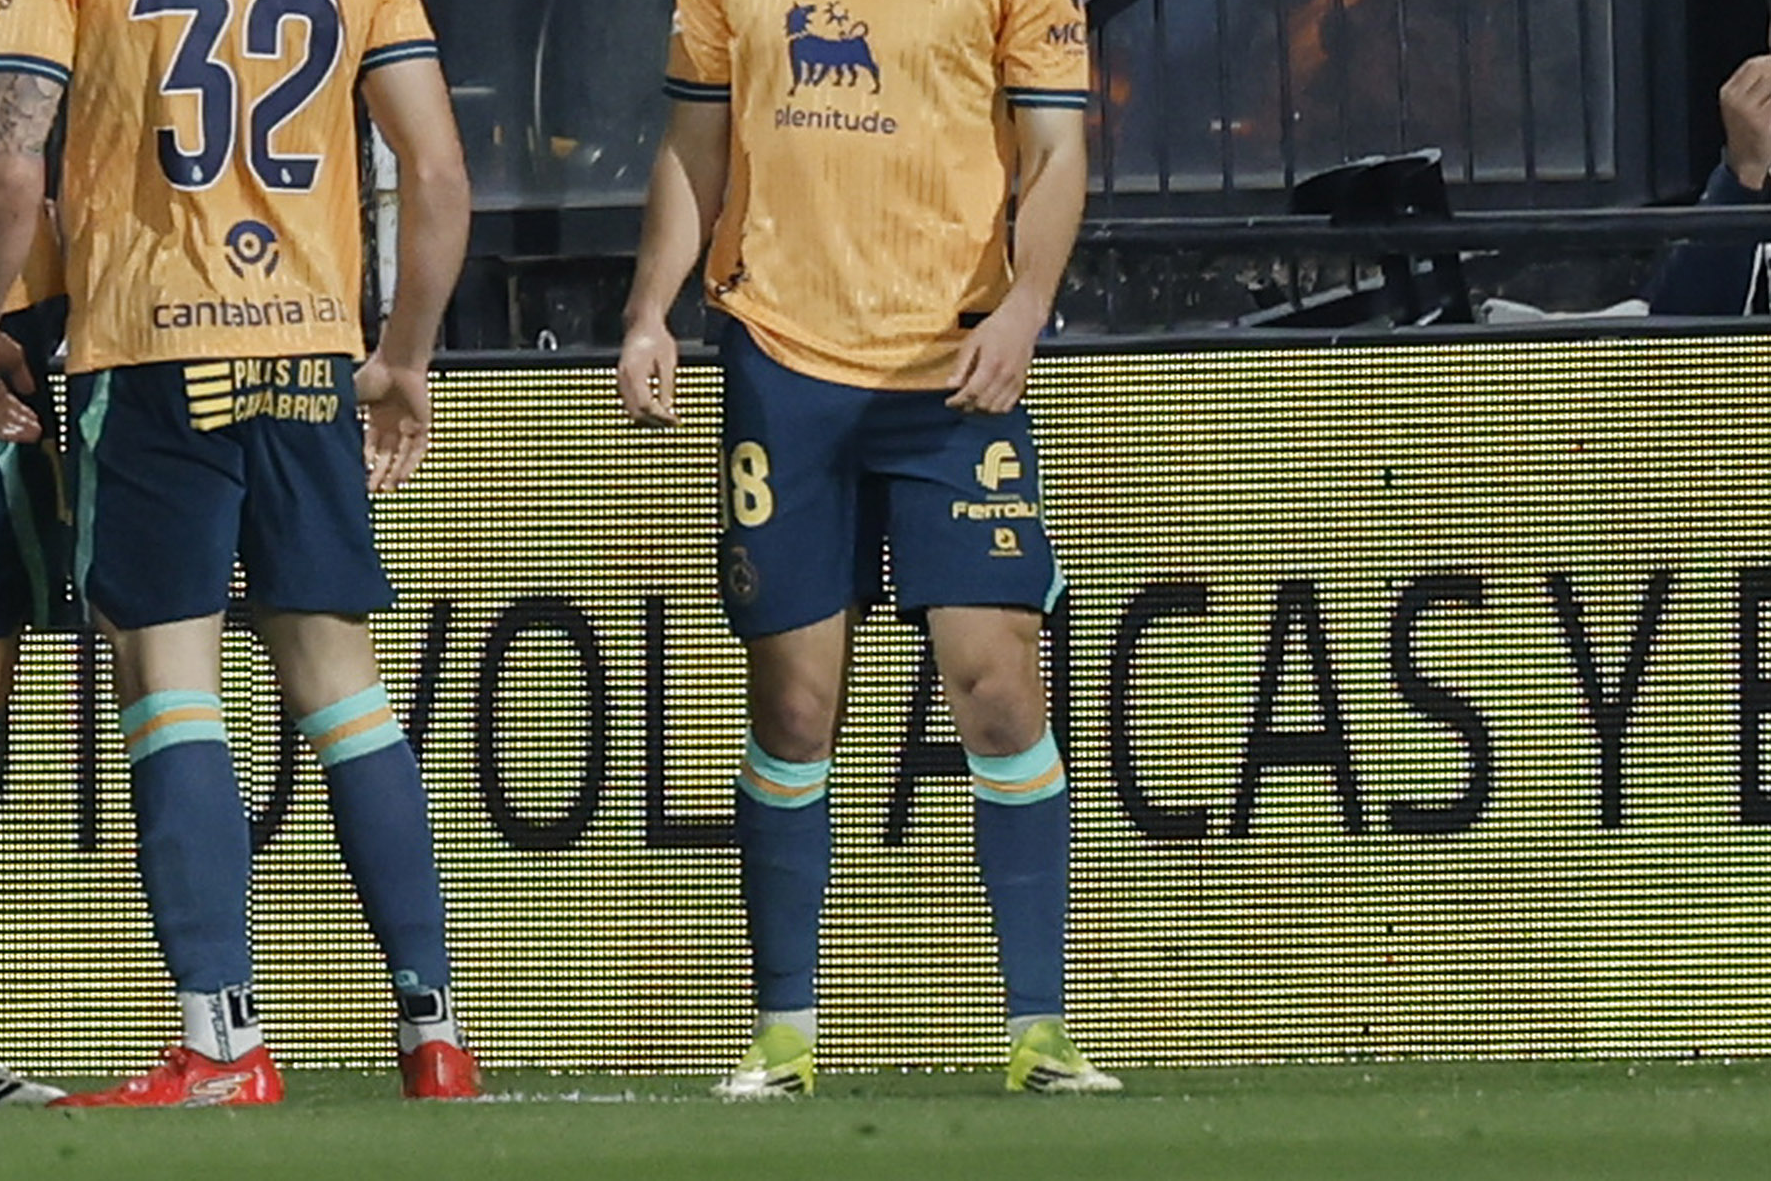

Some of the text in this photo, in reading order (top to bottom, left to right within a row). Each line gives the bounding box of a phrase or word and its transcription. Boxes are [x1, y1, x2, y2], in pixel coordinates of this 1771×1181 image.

[775, 104, 898, 135] plenitude
[153, 294, 304, 329] cantabria
[297, 359, 335, 389] DEL
[729, 439, 775, 528] 8
